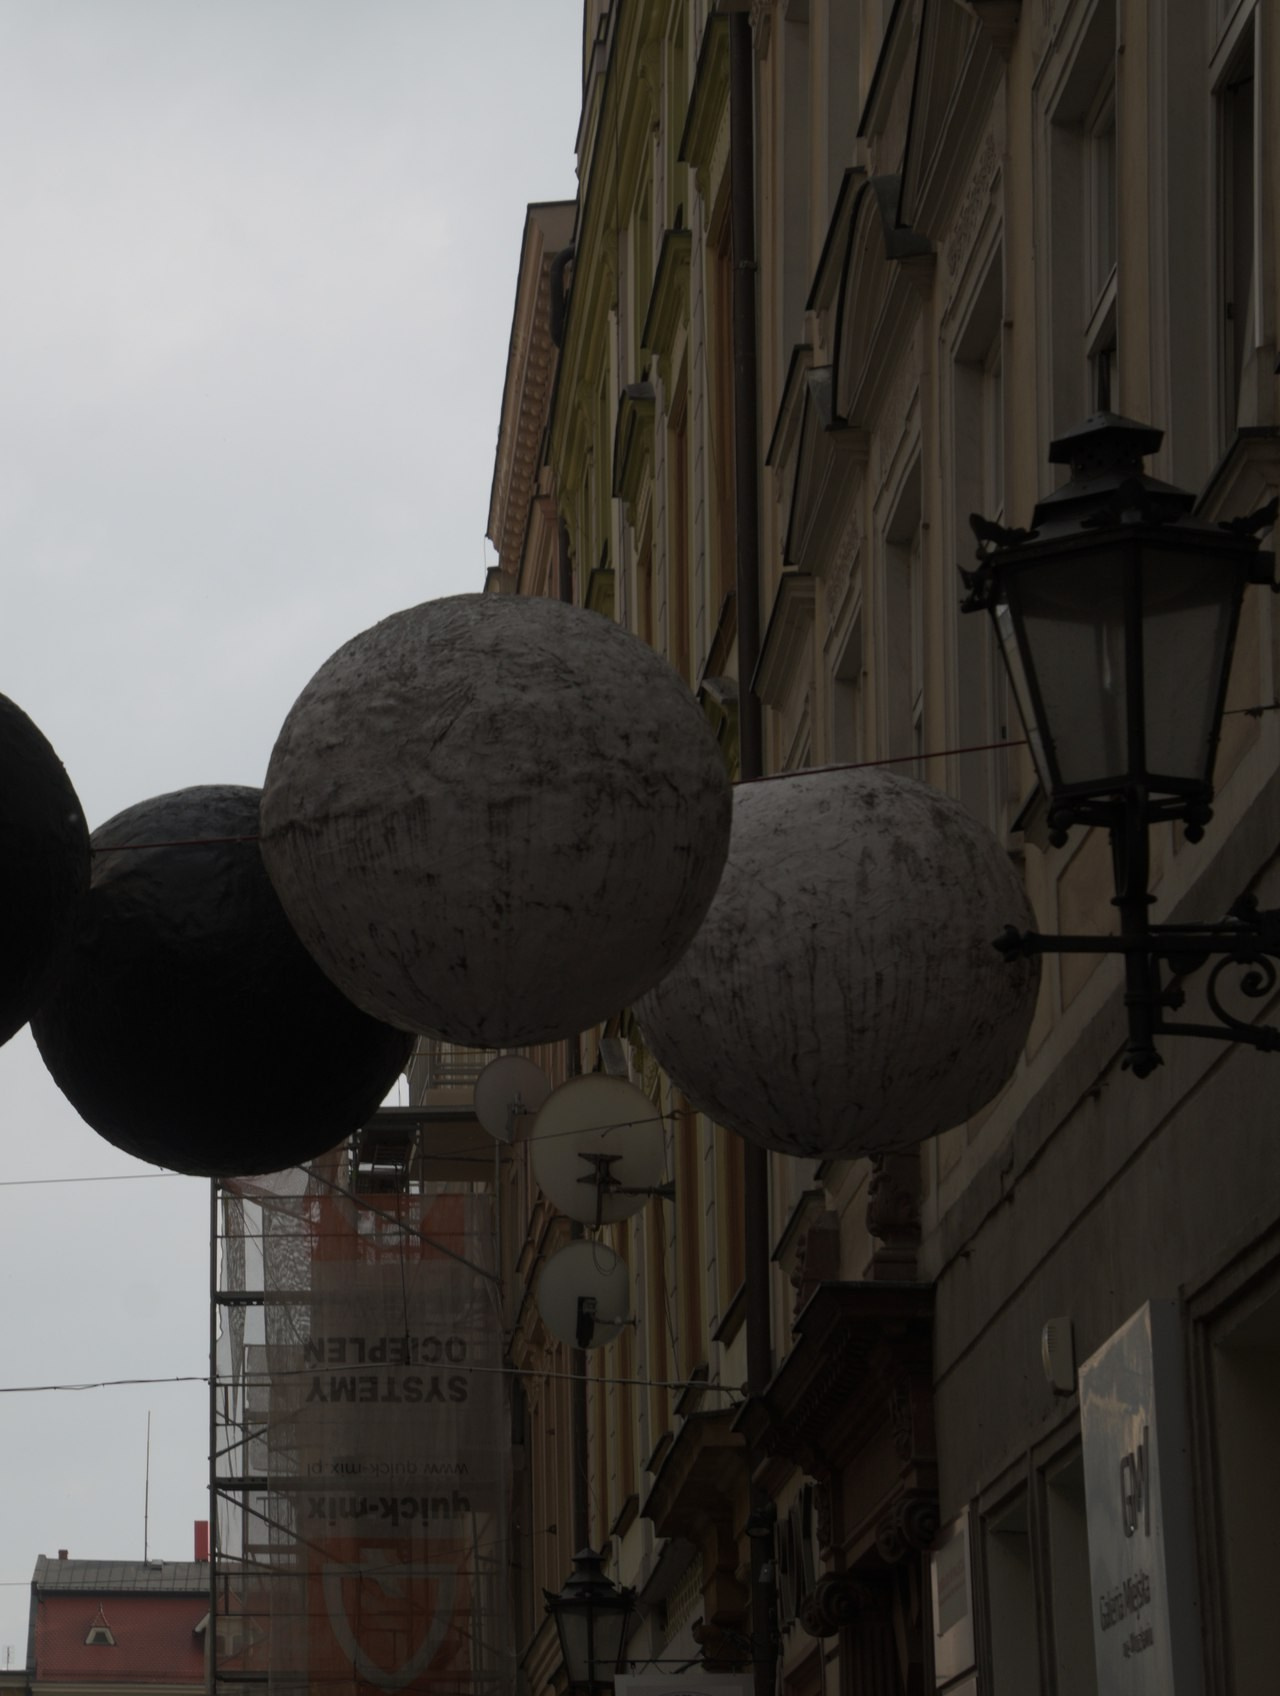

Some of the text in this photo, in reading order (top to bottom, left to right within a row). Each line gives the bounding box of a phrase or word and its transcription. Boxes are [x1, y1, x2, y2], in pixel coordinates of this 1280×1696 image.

[306, 1376, 468, 1403] SYSTEMY
[307, 1461, 469, 1478] www.quick-mix.pl
[307, 1490, 470, 1527] quick-mix
